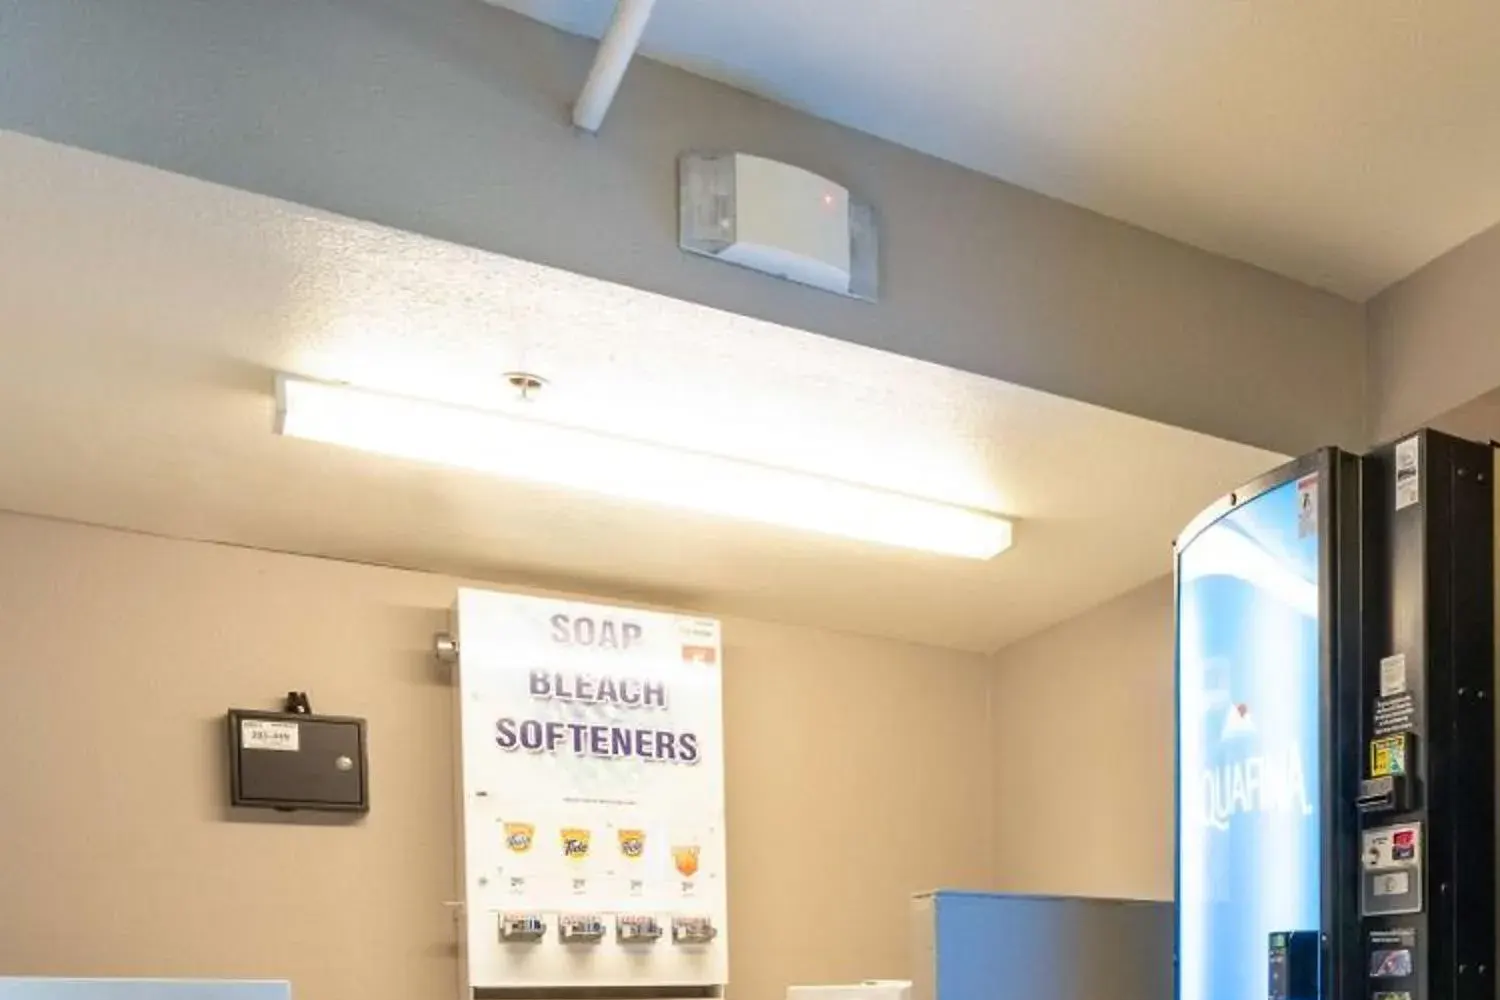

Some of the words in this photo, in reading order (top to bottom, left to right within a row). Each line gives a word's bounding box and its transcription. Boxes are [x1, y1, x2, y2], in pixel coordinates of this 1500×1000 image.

[551, 614, 643, 650] SOAP
[529, 667, 666, 708] BLEACH
[495, 717, 698, 762] SOFTENERS
